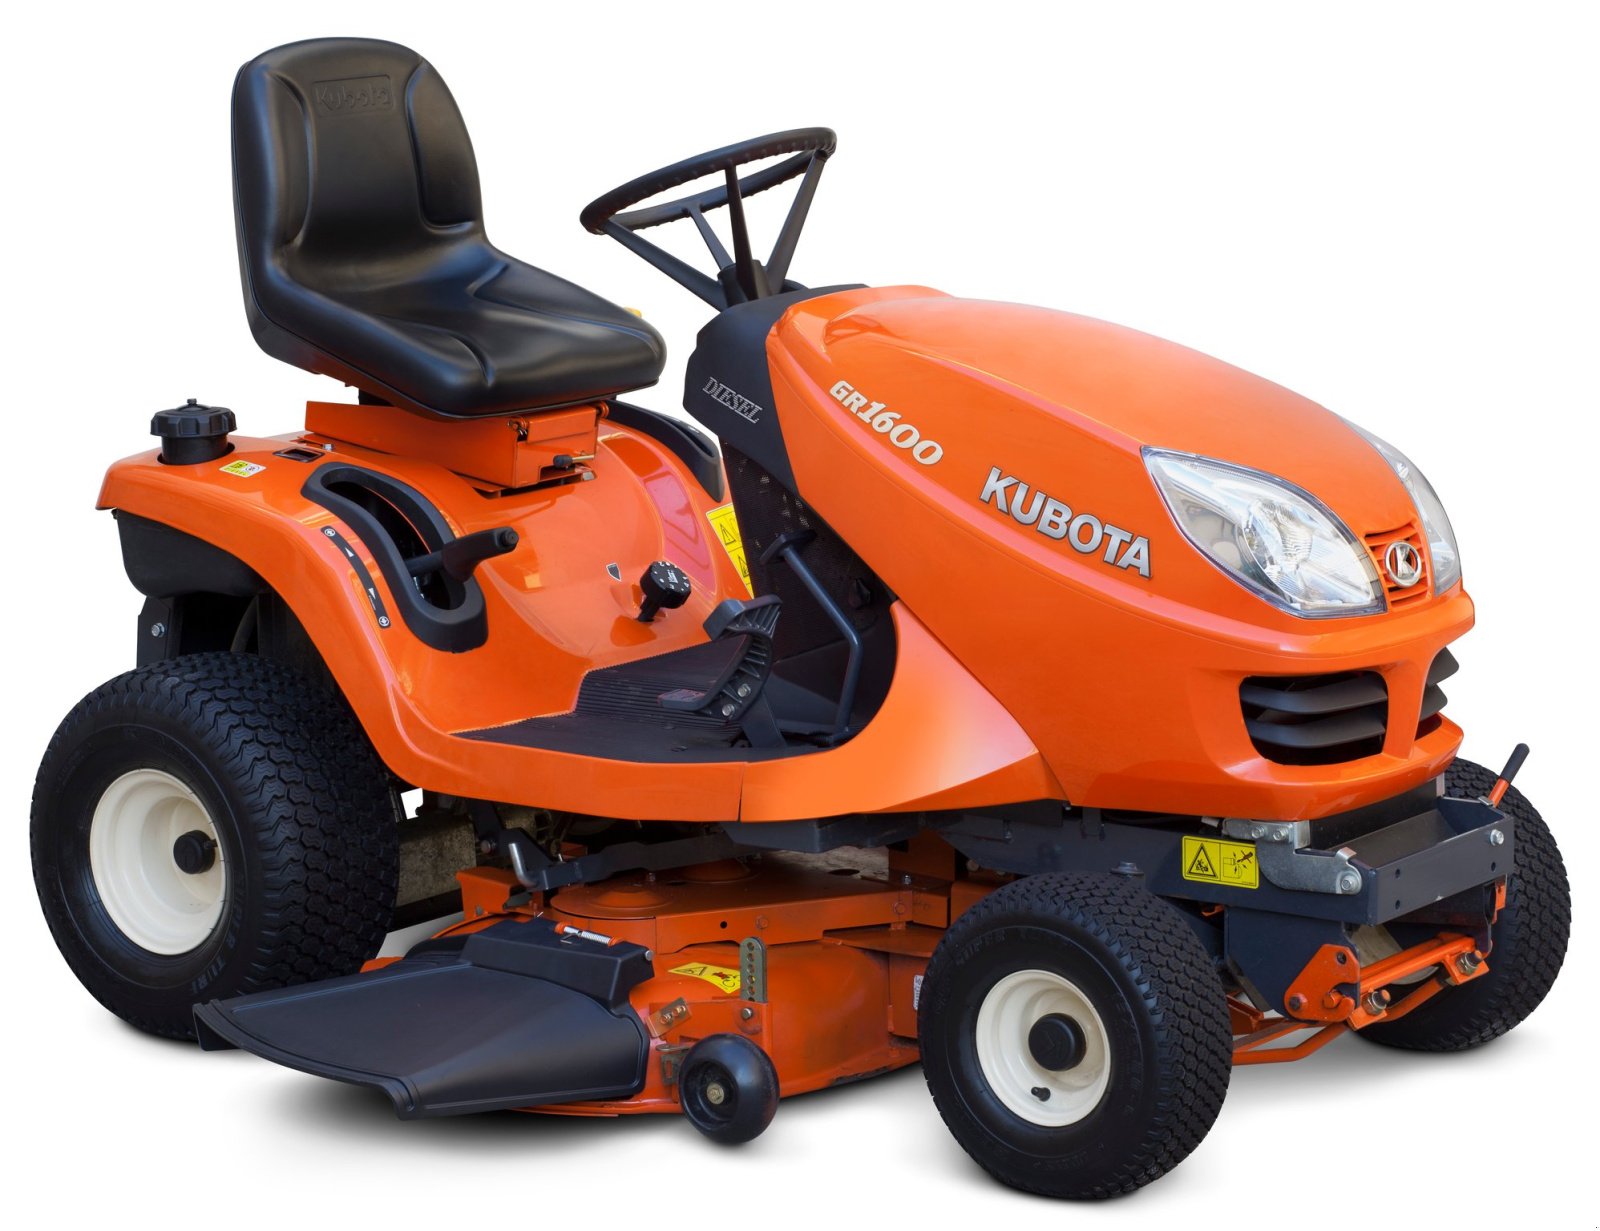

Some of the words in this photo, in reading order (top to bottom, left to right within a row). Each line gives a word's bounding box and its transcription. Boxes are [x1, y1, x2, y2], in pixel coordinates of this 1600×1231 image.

[314, 82, 391, 112] Kubota
[702, 376, 763, 424] DIESEL
[829, 380, 944, 465] GR1600
[979, 465, 1152, 580] KUBOTA
